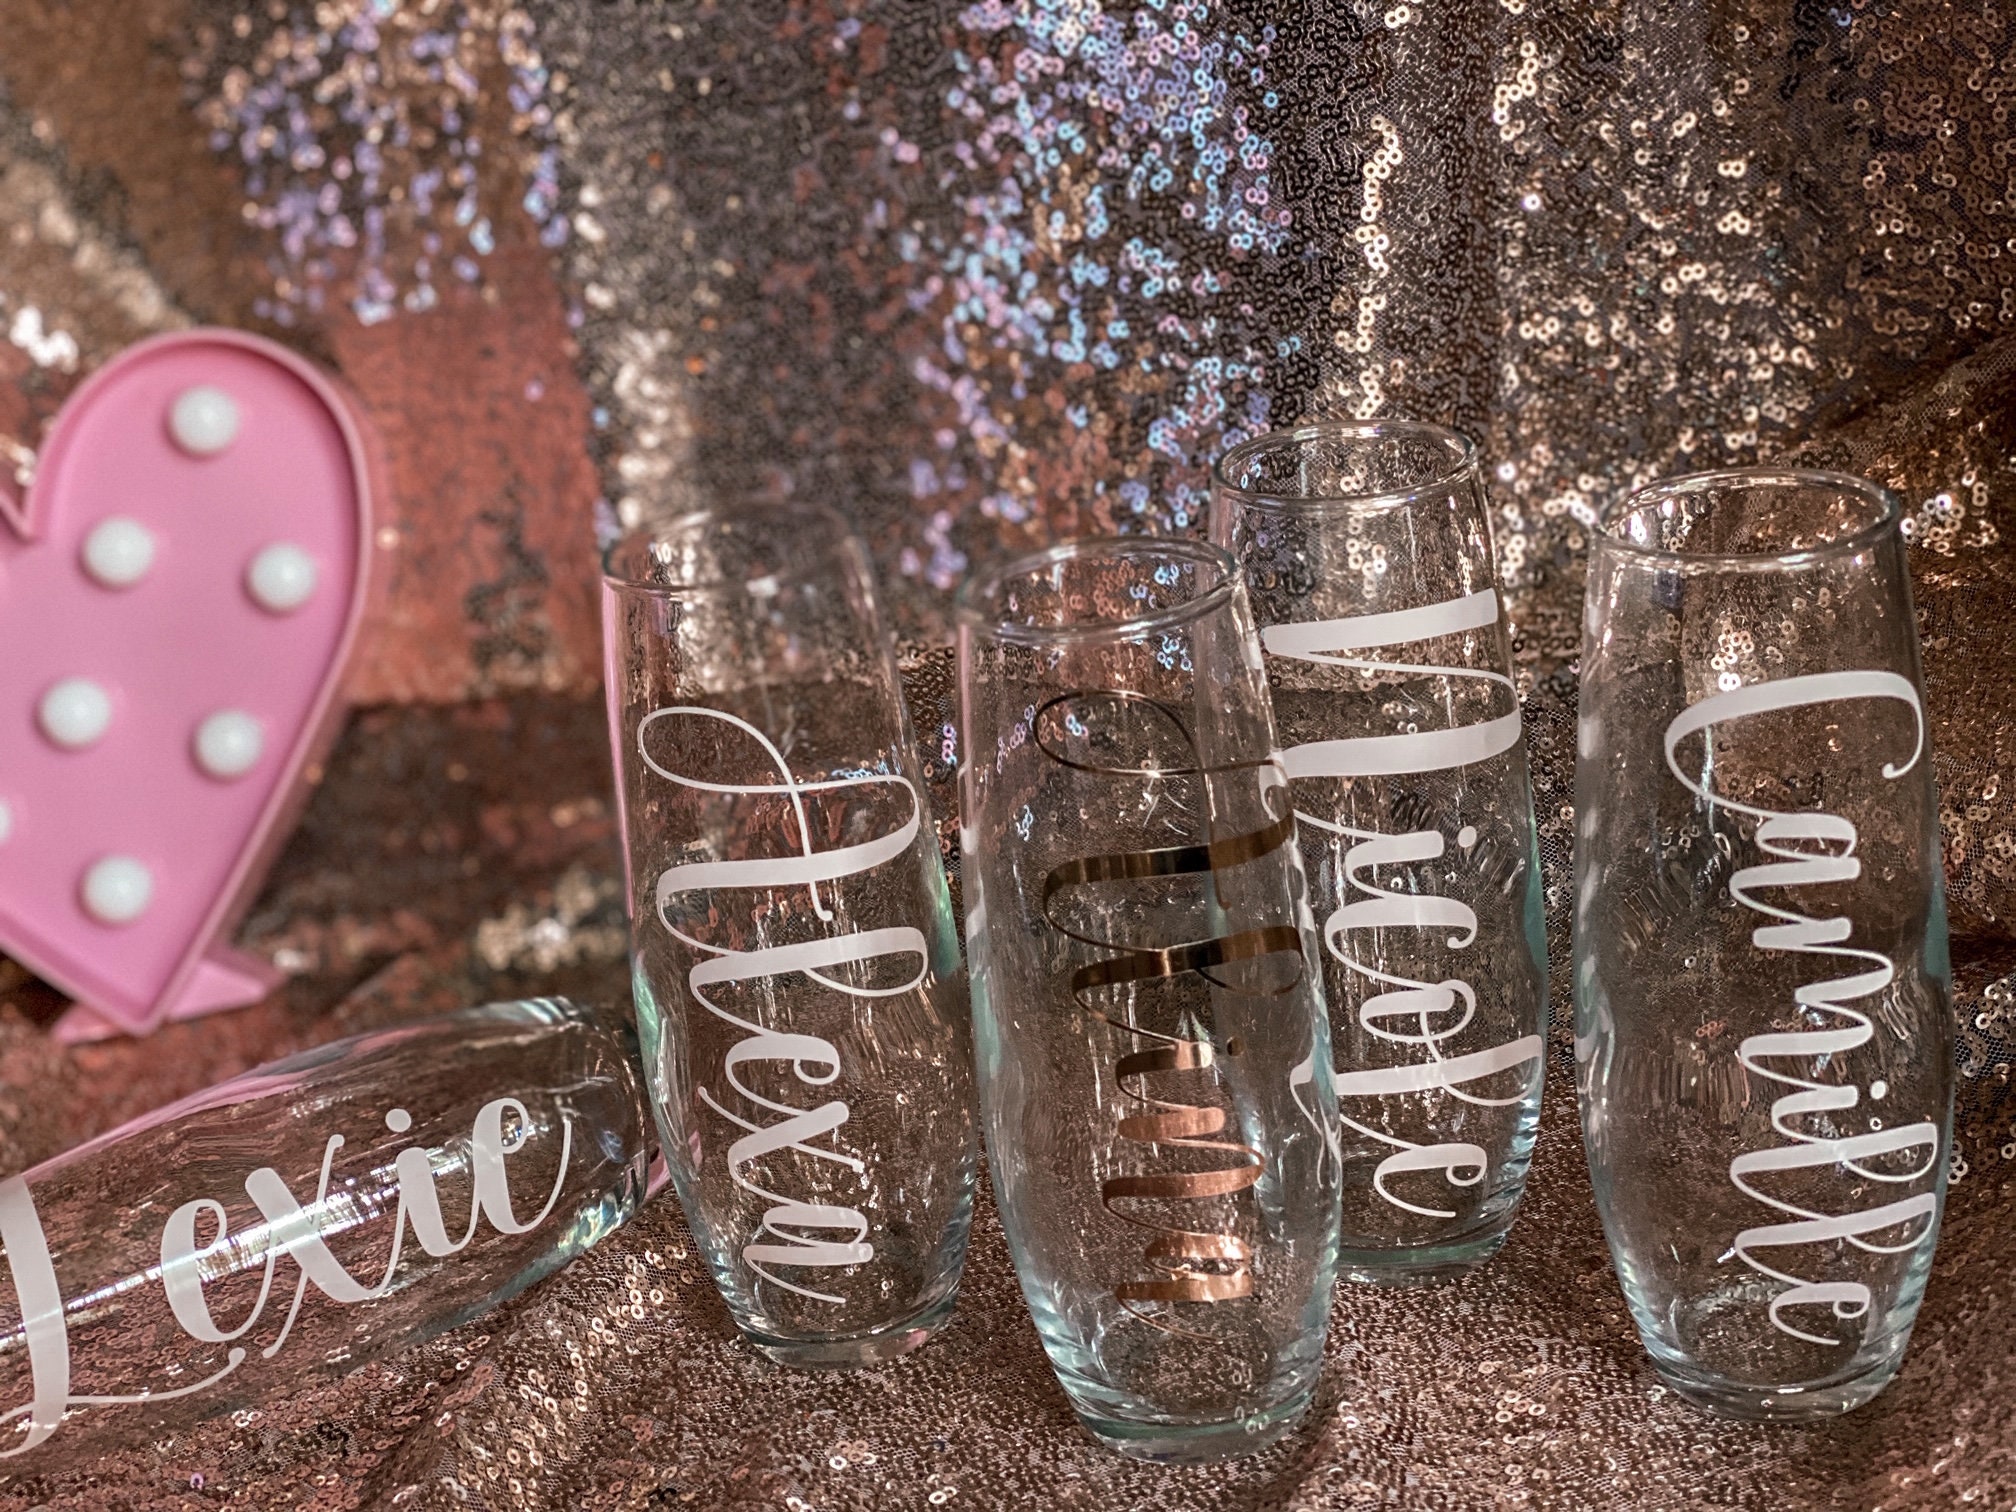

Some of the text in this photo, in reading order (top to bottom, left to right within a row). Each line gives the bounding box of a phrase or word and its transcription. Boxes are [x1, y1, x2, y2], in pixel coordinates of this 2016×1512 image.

[637, 707, 929, 1304] Alexa
[1032, 688, 1304, 1344] Alina
[1261, 587, 1543, 1219] Nicole
[1664, 670, 1938, 1346] Camille
[0, 1098, 571, 1458] Lexie
